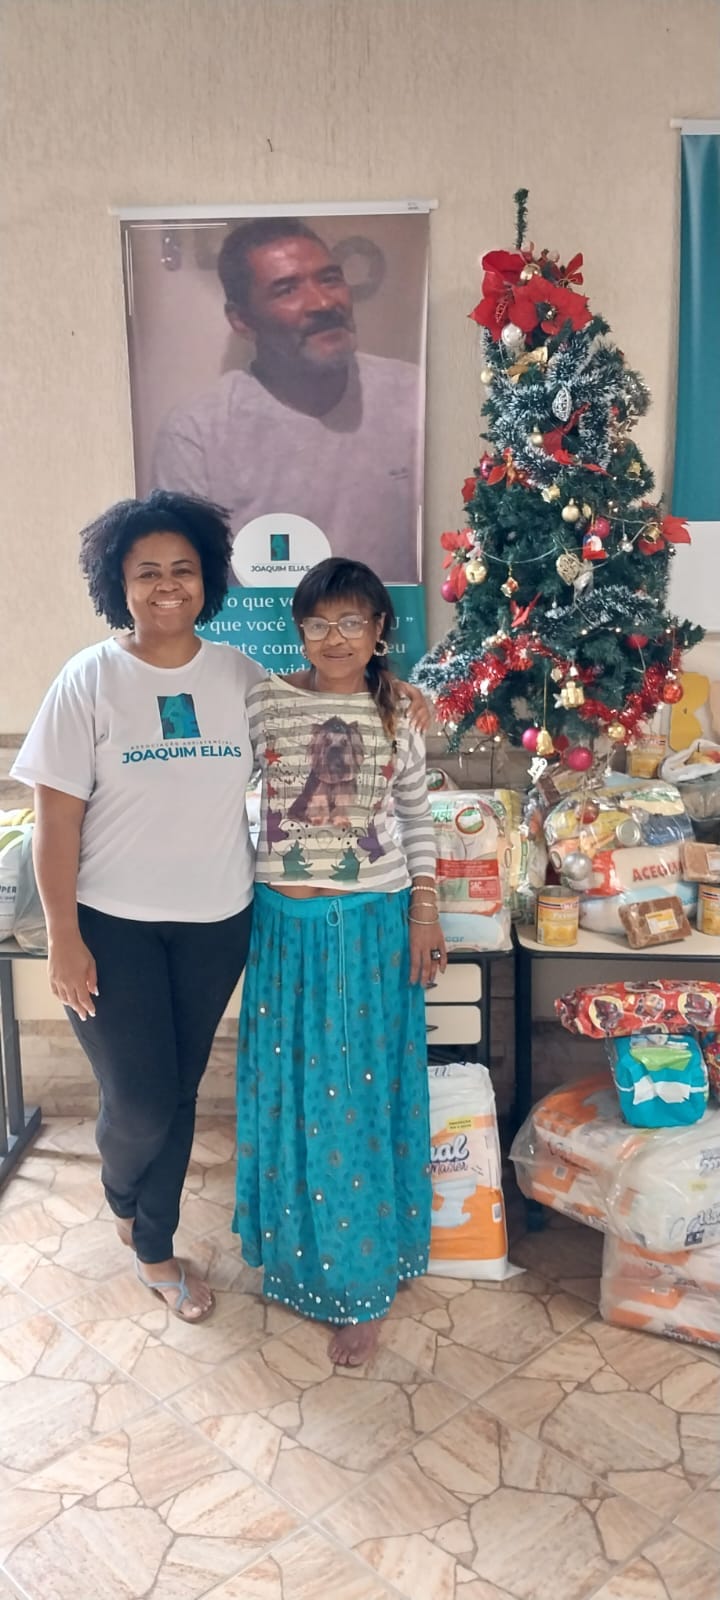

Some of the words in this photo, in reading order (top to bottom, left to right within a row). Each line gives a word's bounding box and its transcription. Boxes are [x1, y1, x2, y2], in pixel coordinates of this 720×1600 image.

[251, 565, 286, 573] JOAQUIM
[242, 597, 274, 611] que
[210, 620, 241, 635] que
[246, 617, 286, 632] você
[122, 746, 197, 764] JOAQUIM
[200, 745, 242, 758] ELIAS
[0, 885, 17, 894] PER
